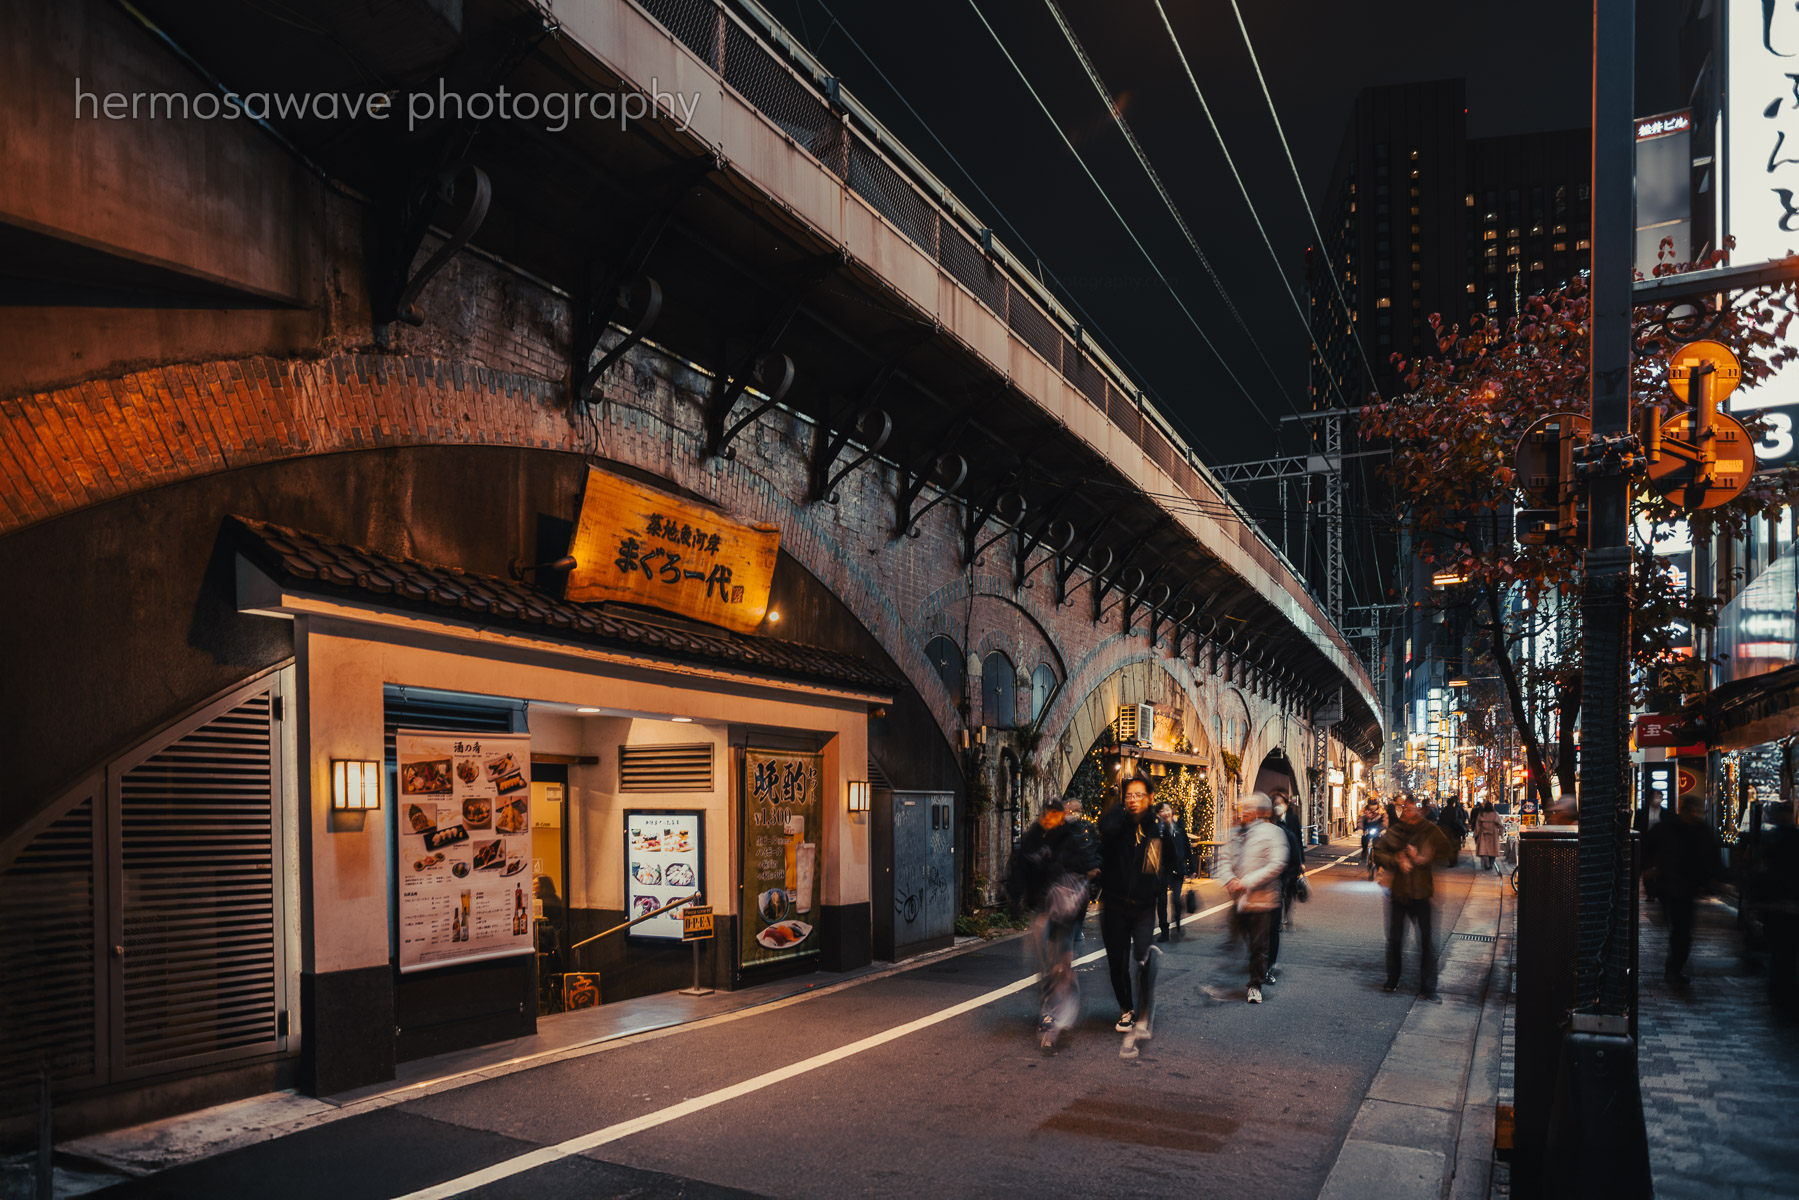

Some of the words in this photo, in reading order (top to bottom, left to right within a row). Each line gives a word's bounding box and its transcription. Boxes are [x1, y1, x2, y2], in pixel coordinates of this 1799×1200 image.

[646, 512, 723, 556] 築地魚河岸
[615, 537, 733, 603] まぐろ一代
[453, 741, 482, 754] 酒の肴
[752, 759, 808, 805] 晩酌
[754, 807, 792, 828] ¥1,300
